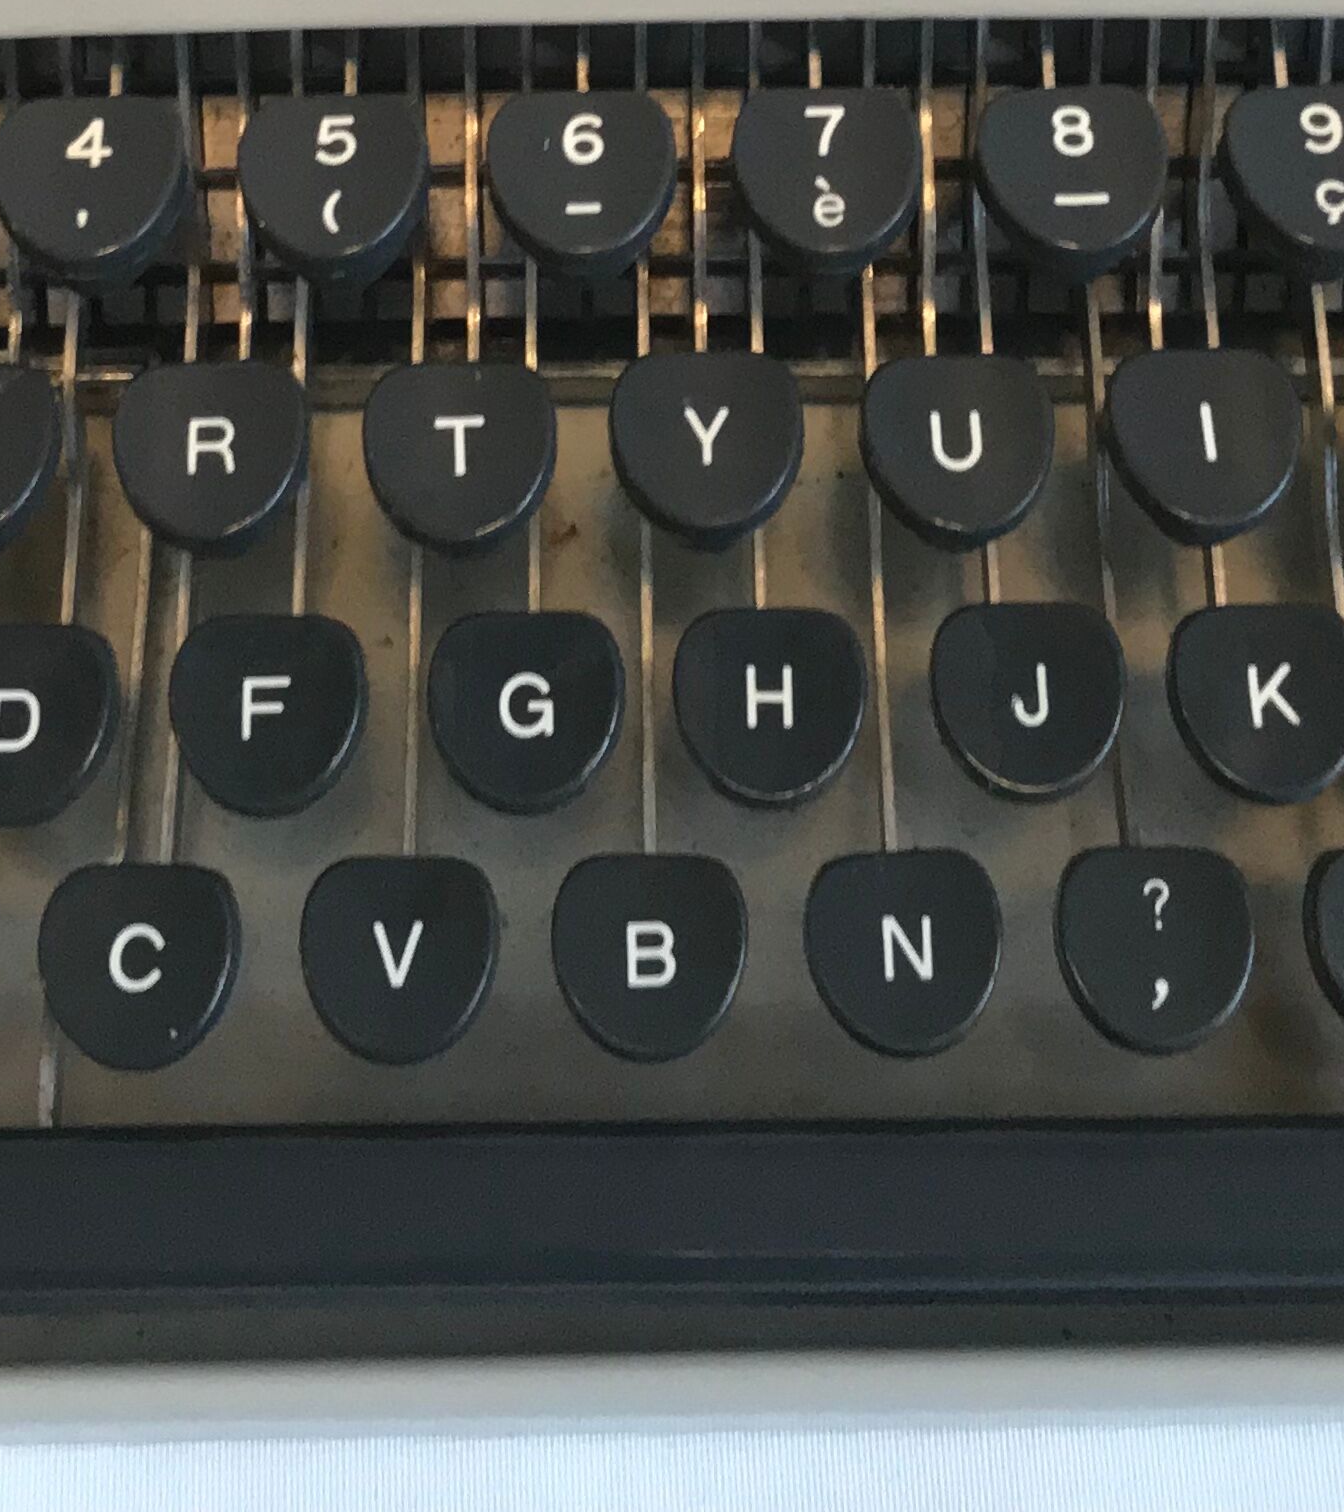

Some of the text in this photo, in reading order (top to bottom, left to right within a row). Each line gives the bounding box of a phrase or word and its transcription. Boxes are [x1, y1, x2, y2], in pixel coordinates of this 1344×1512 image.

[64, 116, 114, 169] 4
[314, 114, 358, 167] 5
[561, 112, 606, 166] 6
[803, 104, 846, 158] 7
[1050, 104, 1095, 158] 8
[1298, 102, 1344, 156] 9
[321, 189, 342, 235] (
[812, 174, 847, 229] è
[186, 415, 236, 476] R
[432, 414, 486, 478] T
[683, 405, 730, 467] Y
[928, 407, 984, 473] U
[1199, 401, 1219, 463] I
[240, 675, 292, 742] F
[498, 671, 555, 740] G
[745, 663, 795, 730] H
[1011, 662, 1050, 728] J
[1246, 662, 1301, 730] K
[1142, 877, 1171, 931] ?
[108, 922, 166, 993] C
[372, 919, 425, 989] V
[625, 920, 677, 989] B
[881, 914, 934, 982] N
